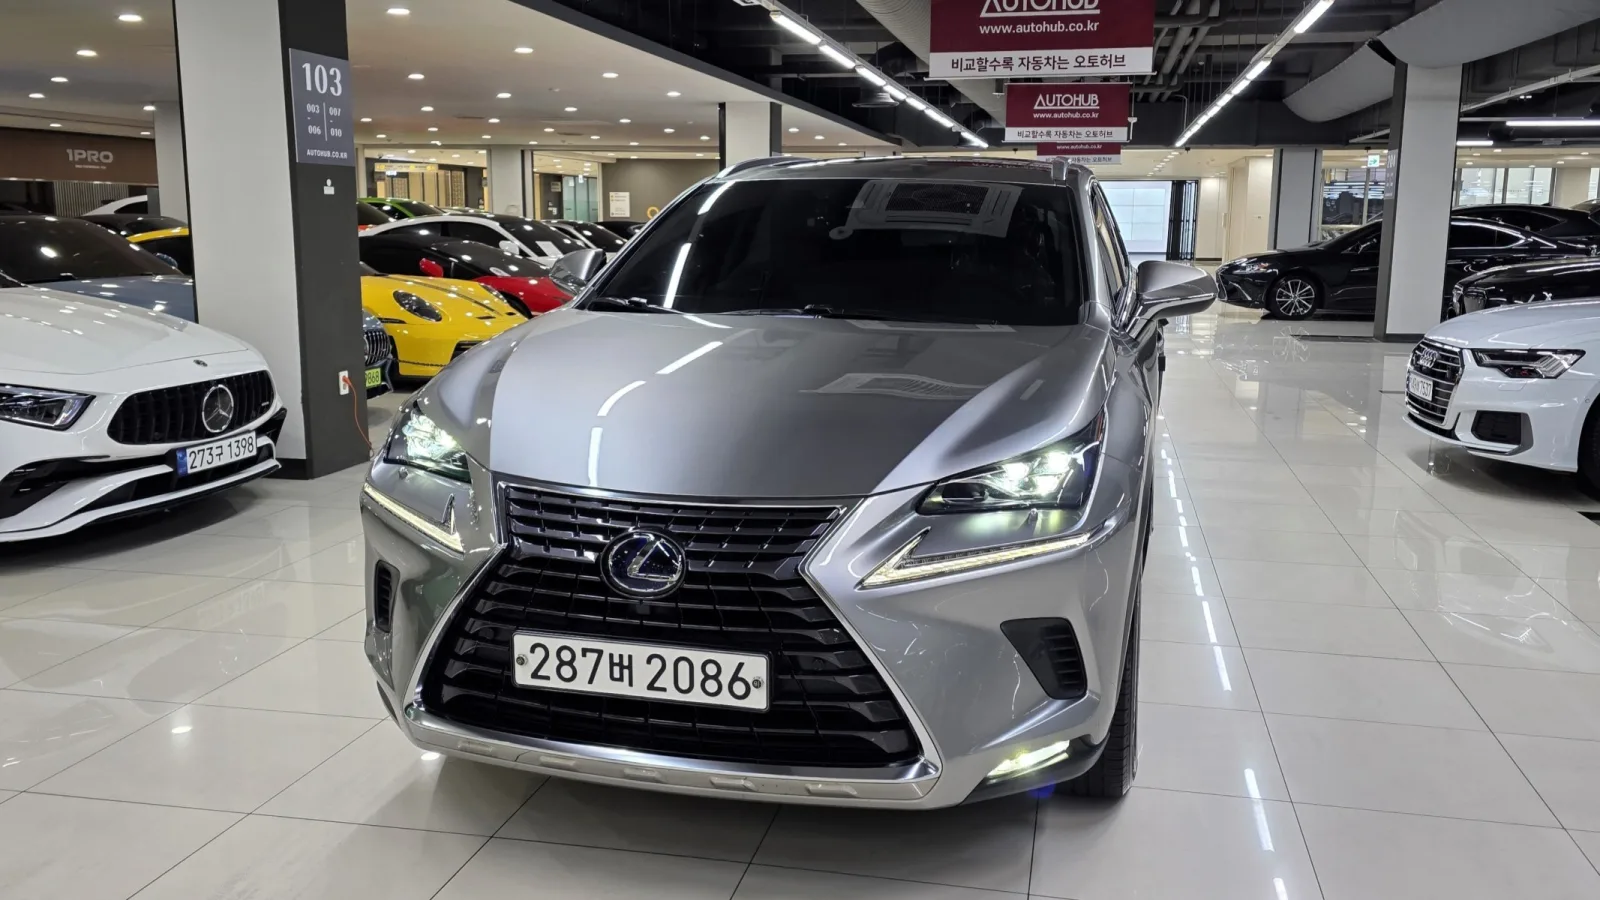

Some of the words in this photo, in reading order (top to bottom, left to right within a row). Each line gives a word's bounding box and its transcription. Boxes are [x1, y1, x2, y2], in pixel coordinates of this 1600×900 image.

[980, 20, 1099, 34] www.autohub.co.kr
[951, 57, 1014, 72] 비교할수록
[1018, 55, 1069, 71] 자동차는
[1073, 54, 1126, 69] 오토허브
[302, 63, 342, 96] 103
[306, 103, 320, 114] 003
[1033, 93, 1100, 110] AUTOHUB
[1033, 111, 1099, 119] www.autohub.co.kr
[1017, 130, 1052, 139] 비교할수록
[1054, 130, 1082, 139] 자동차는
[1084, 130, 1113, 138] 오토허브
[306, 149, 348, 159] AUTOHUB.CO.KR
[189, 445, 223, 470] 273구
[228, 436, 253, 459] 1398
[529, 642, 633, 687] 287버
[646, 653, 751, 700] 2086
